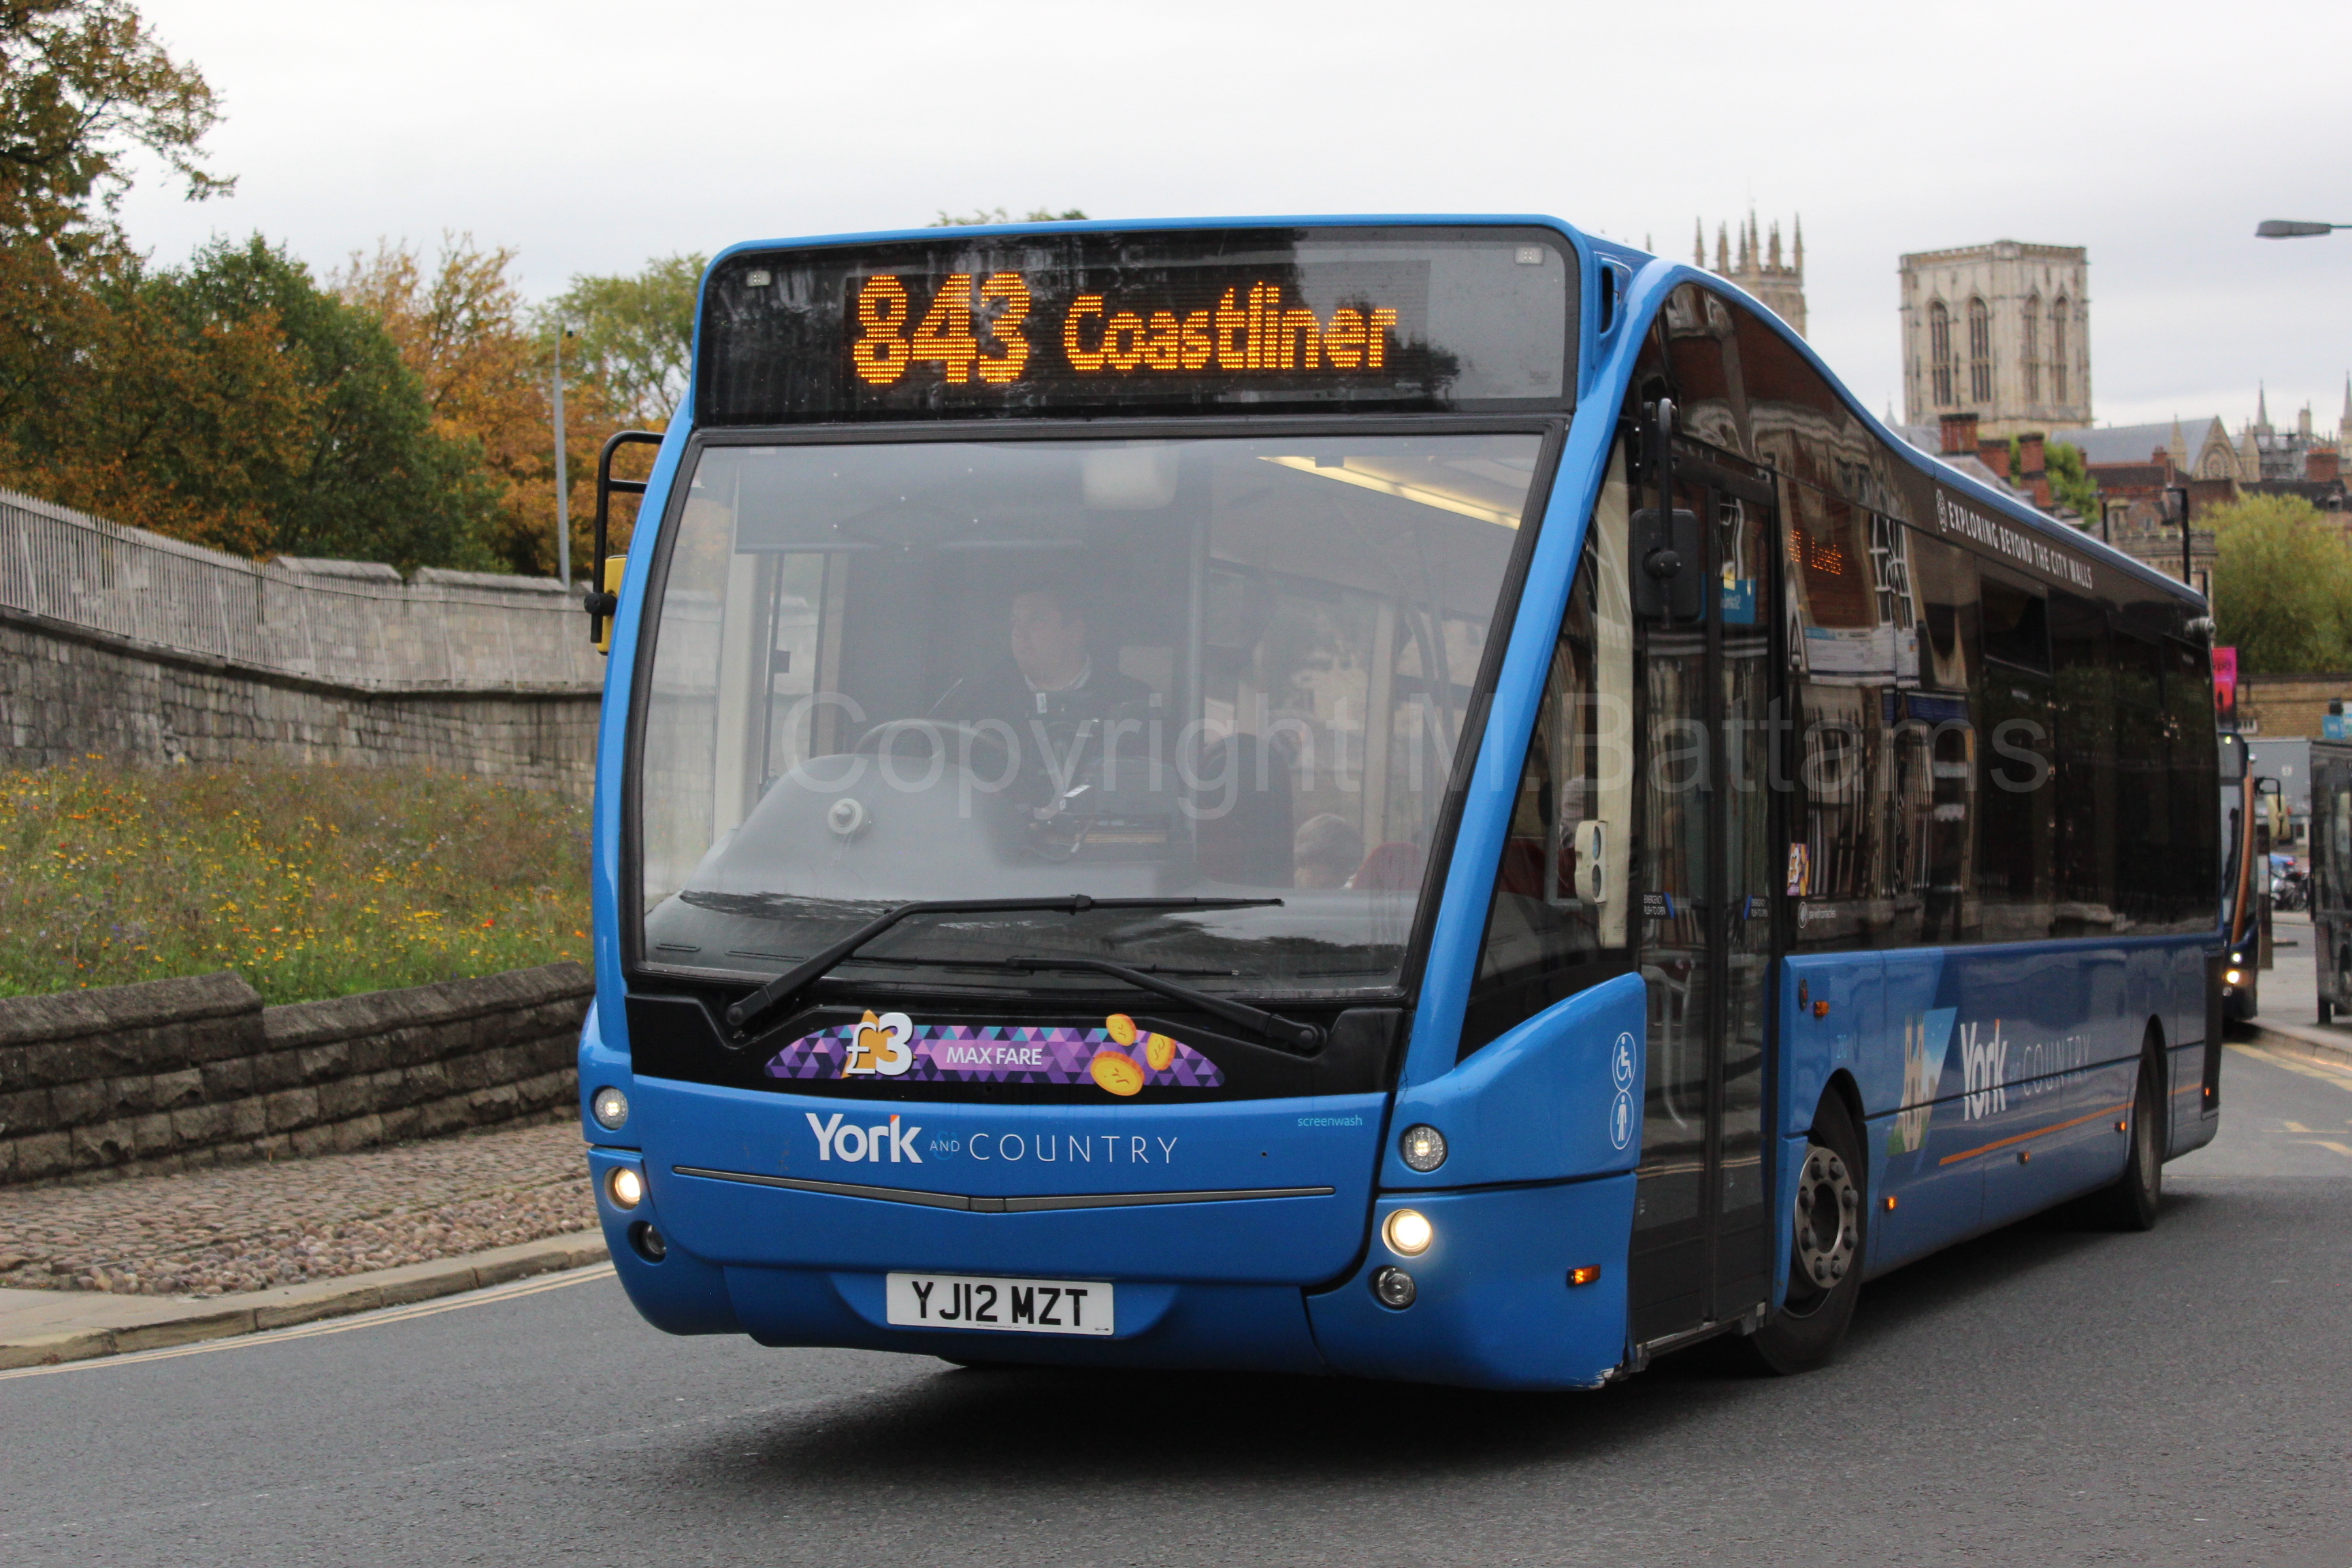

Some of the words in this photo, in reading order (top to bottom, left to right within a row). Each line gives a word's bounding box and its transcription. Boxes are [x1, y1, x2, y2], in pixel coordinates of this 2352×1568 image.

[853, 273, 1031, 385] 843
[1063, 280, 1398, 370] Coastliner
[1947, 500, 1999, 549] EXPLORING
[1999, 525, 2033, 564] BEYOND
[2033, 542, 2050, 572] THE
[2051, 550, 2068, 579] CITY
[2068, 558, 2093, 590] WALLS
[845, 1011, 913, 1075] £3
[945, 1047, 992, 1064] MAX
[996, 1047, 1043, 1065] FARE
[1960, 1019, 2008, 1122] York
[805, 1113, 923, 1164] York
[929, 1141, 960, 1152] AND
[969, 1133, 1178, 1164] COUNTRY
[1297, 1114, 1363, 1127] screenwash
[911, 1281, 998, 1323] YJ12
[1011, 1286, 1088, 1326] MZT
